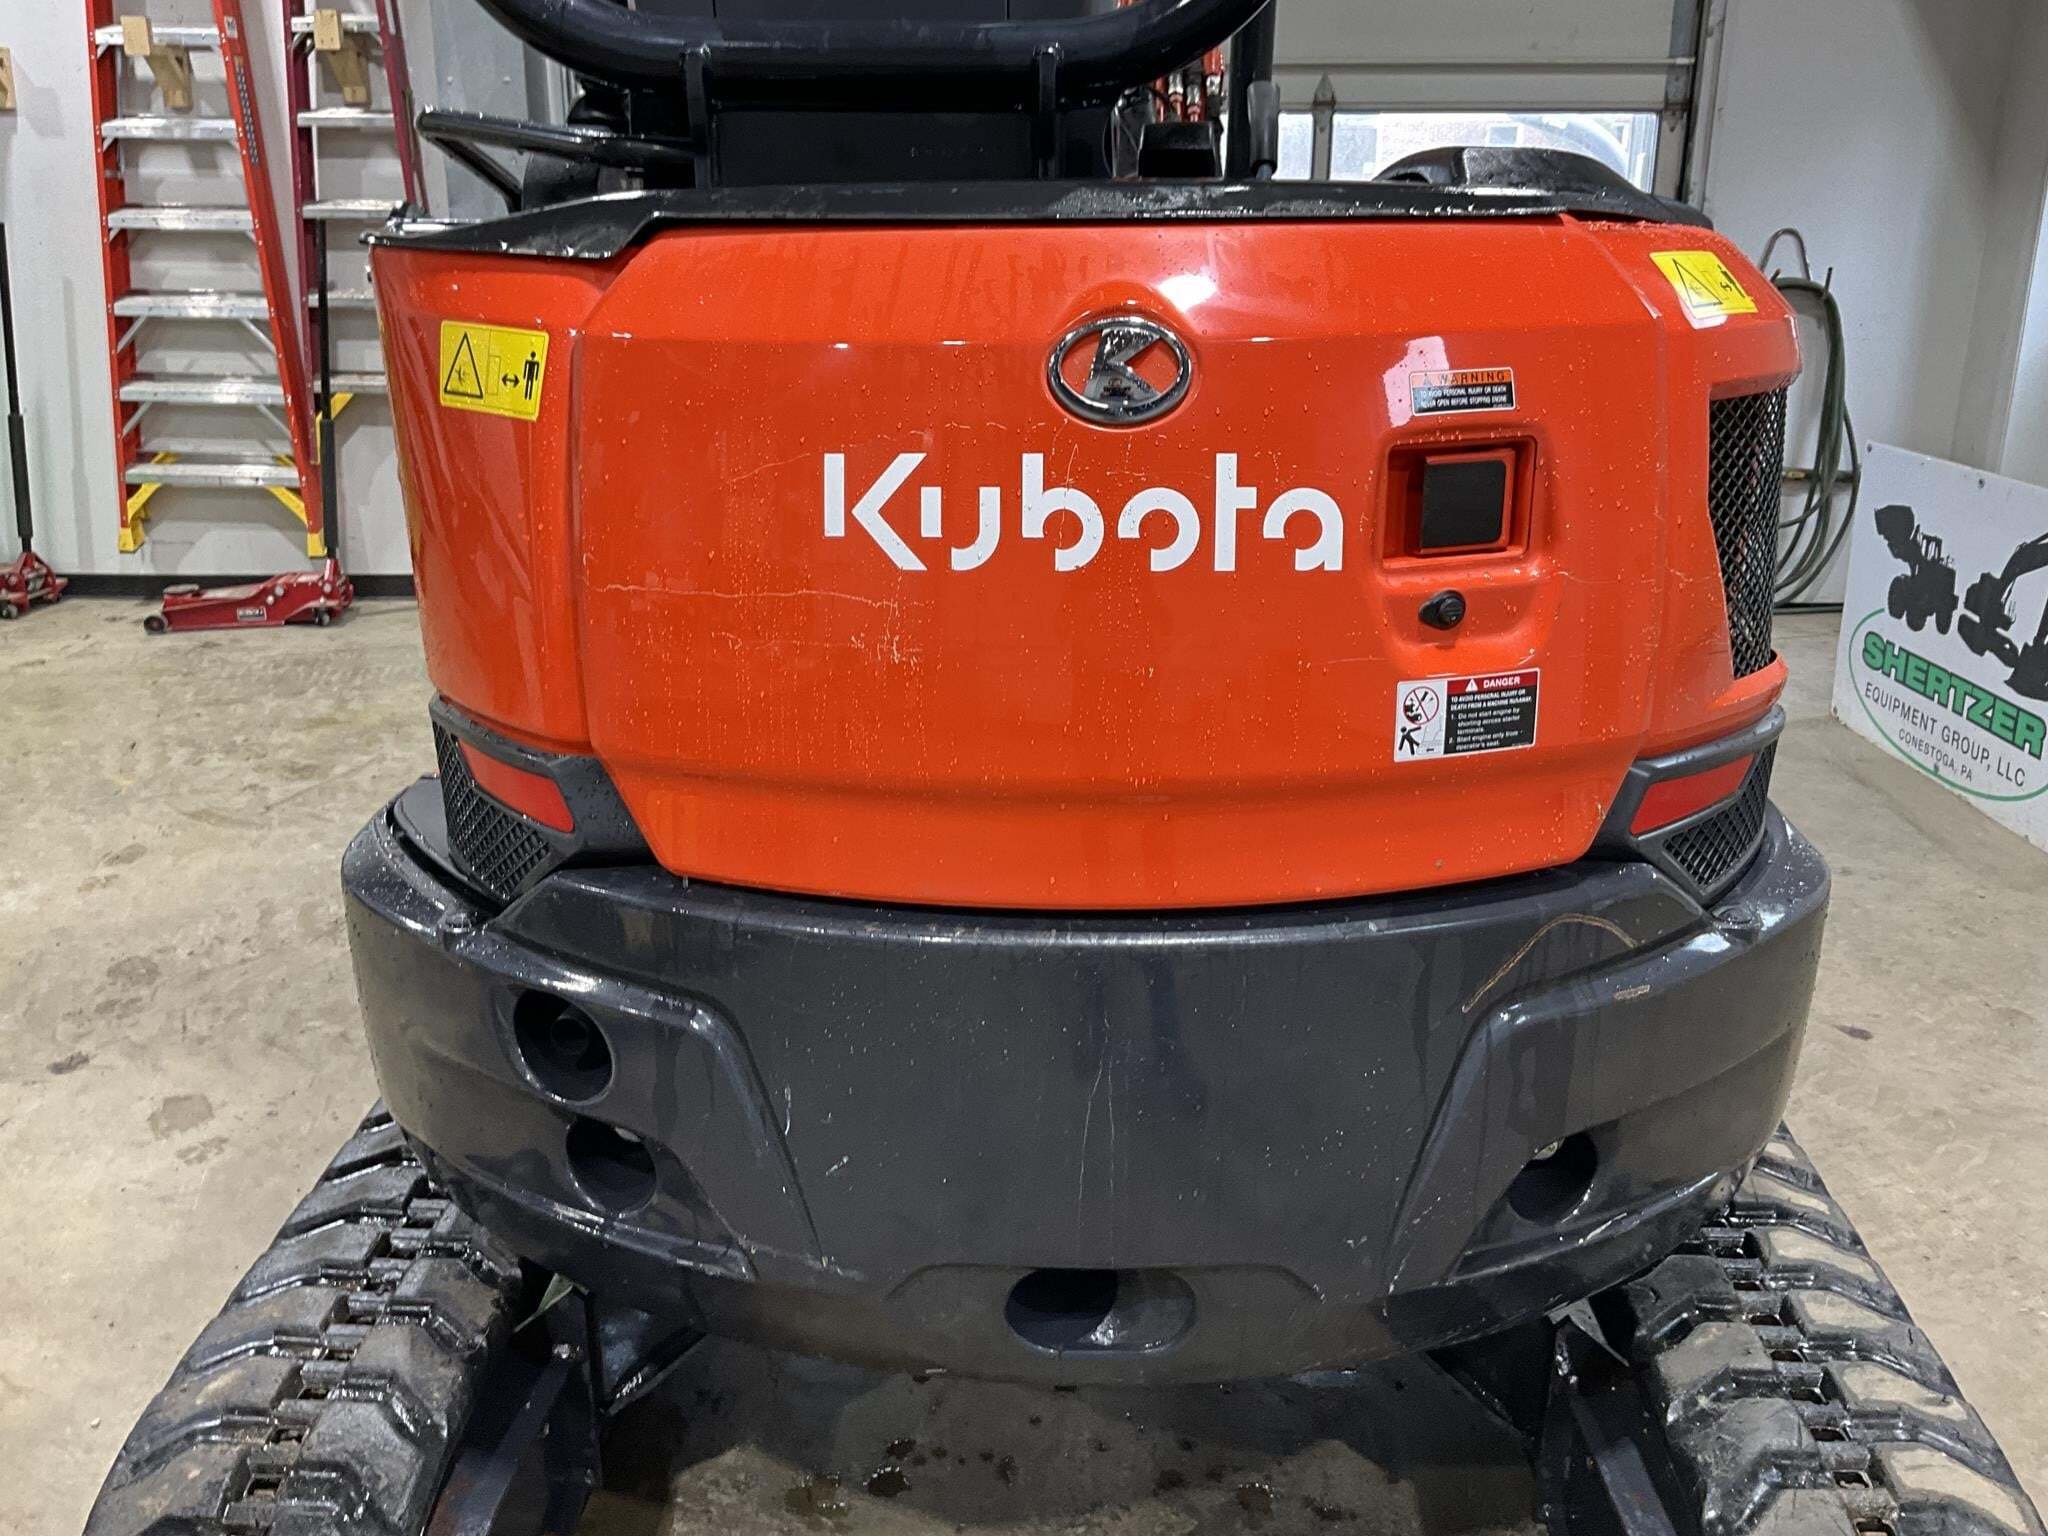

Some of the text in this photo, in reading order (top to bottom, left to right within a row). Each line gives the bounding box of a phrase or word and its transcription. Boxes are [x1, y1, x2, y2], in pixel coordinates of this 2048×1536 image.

[1440, 371, 1505, 385] WARNING
[823, 453, 1344, 572] Kubota
[1483, 676, 1520, 688] DANGER
[1451, 695, 1458, 703] TO
[1459, 694, 1473, 702] AVOID
[1474, 691, 1500, 701] PERSONAL
[1862, 631, 2047, 760] SHERTZER
[1468, 701, 1482, 710] FROM
[1458, 712, 1467, 720] Do
[1468, 711, 1478, 719] not
[1479, 710, 1492, 718] start
[1493, 708, 1512, 717] engine
[1513, 707, 1520, 715] by
[1458, 714, 1520, 728] shorting across starter
[1457, 735, 1471, 743] Start
[1472, 734, 1492, 742] engine
[1492, 732, 1504, 740] only
[1505, 730, 1518, 738] from
[1865, 682, 2026, 787] EQUIPMENT GROUP, LLC
[1899, 729, 1972, 782] CONESTOGA, PA
